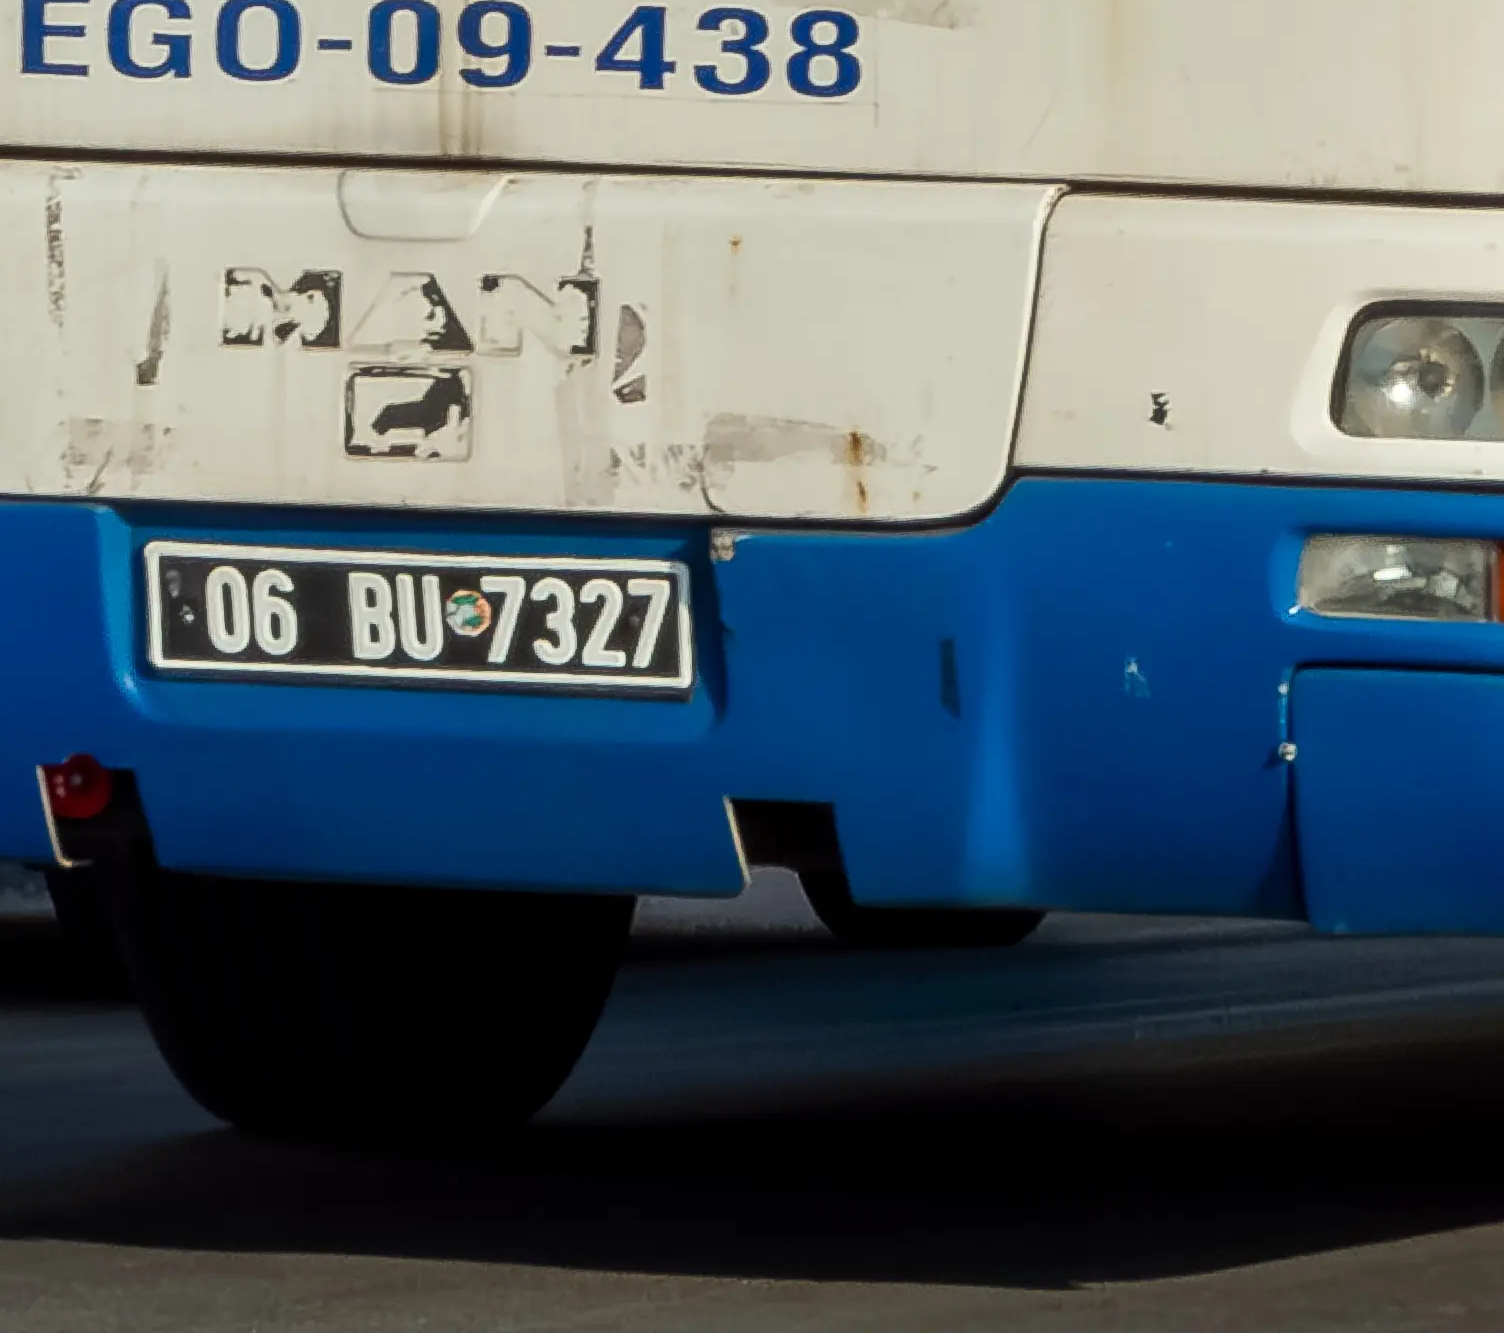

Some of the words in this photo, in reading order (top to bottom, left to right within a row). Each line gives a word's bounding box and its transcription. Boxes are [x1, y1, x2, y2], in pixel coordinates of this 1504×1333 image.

[204, 564, 296, 656] 06
[347, 572, 444, 661] BU
[481, 575, 672, 670] 7327
